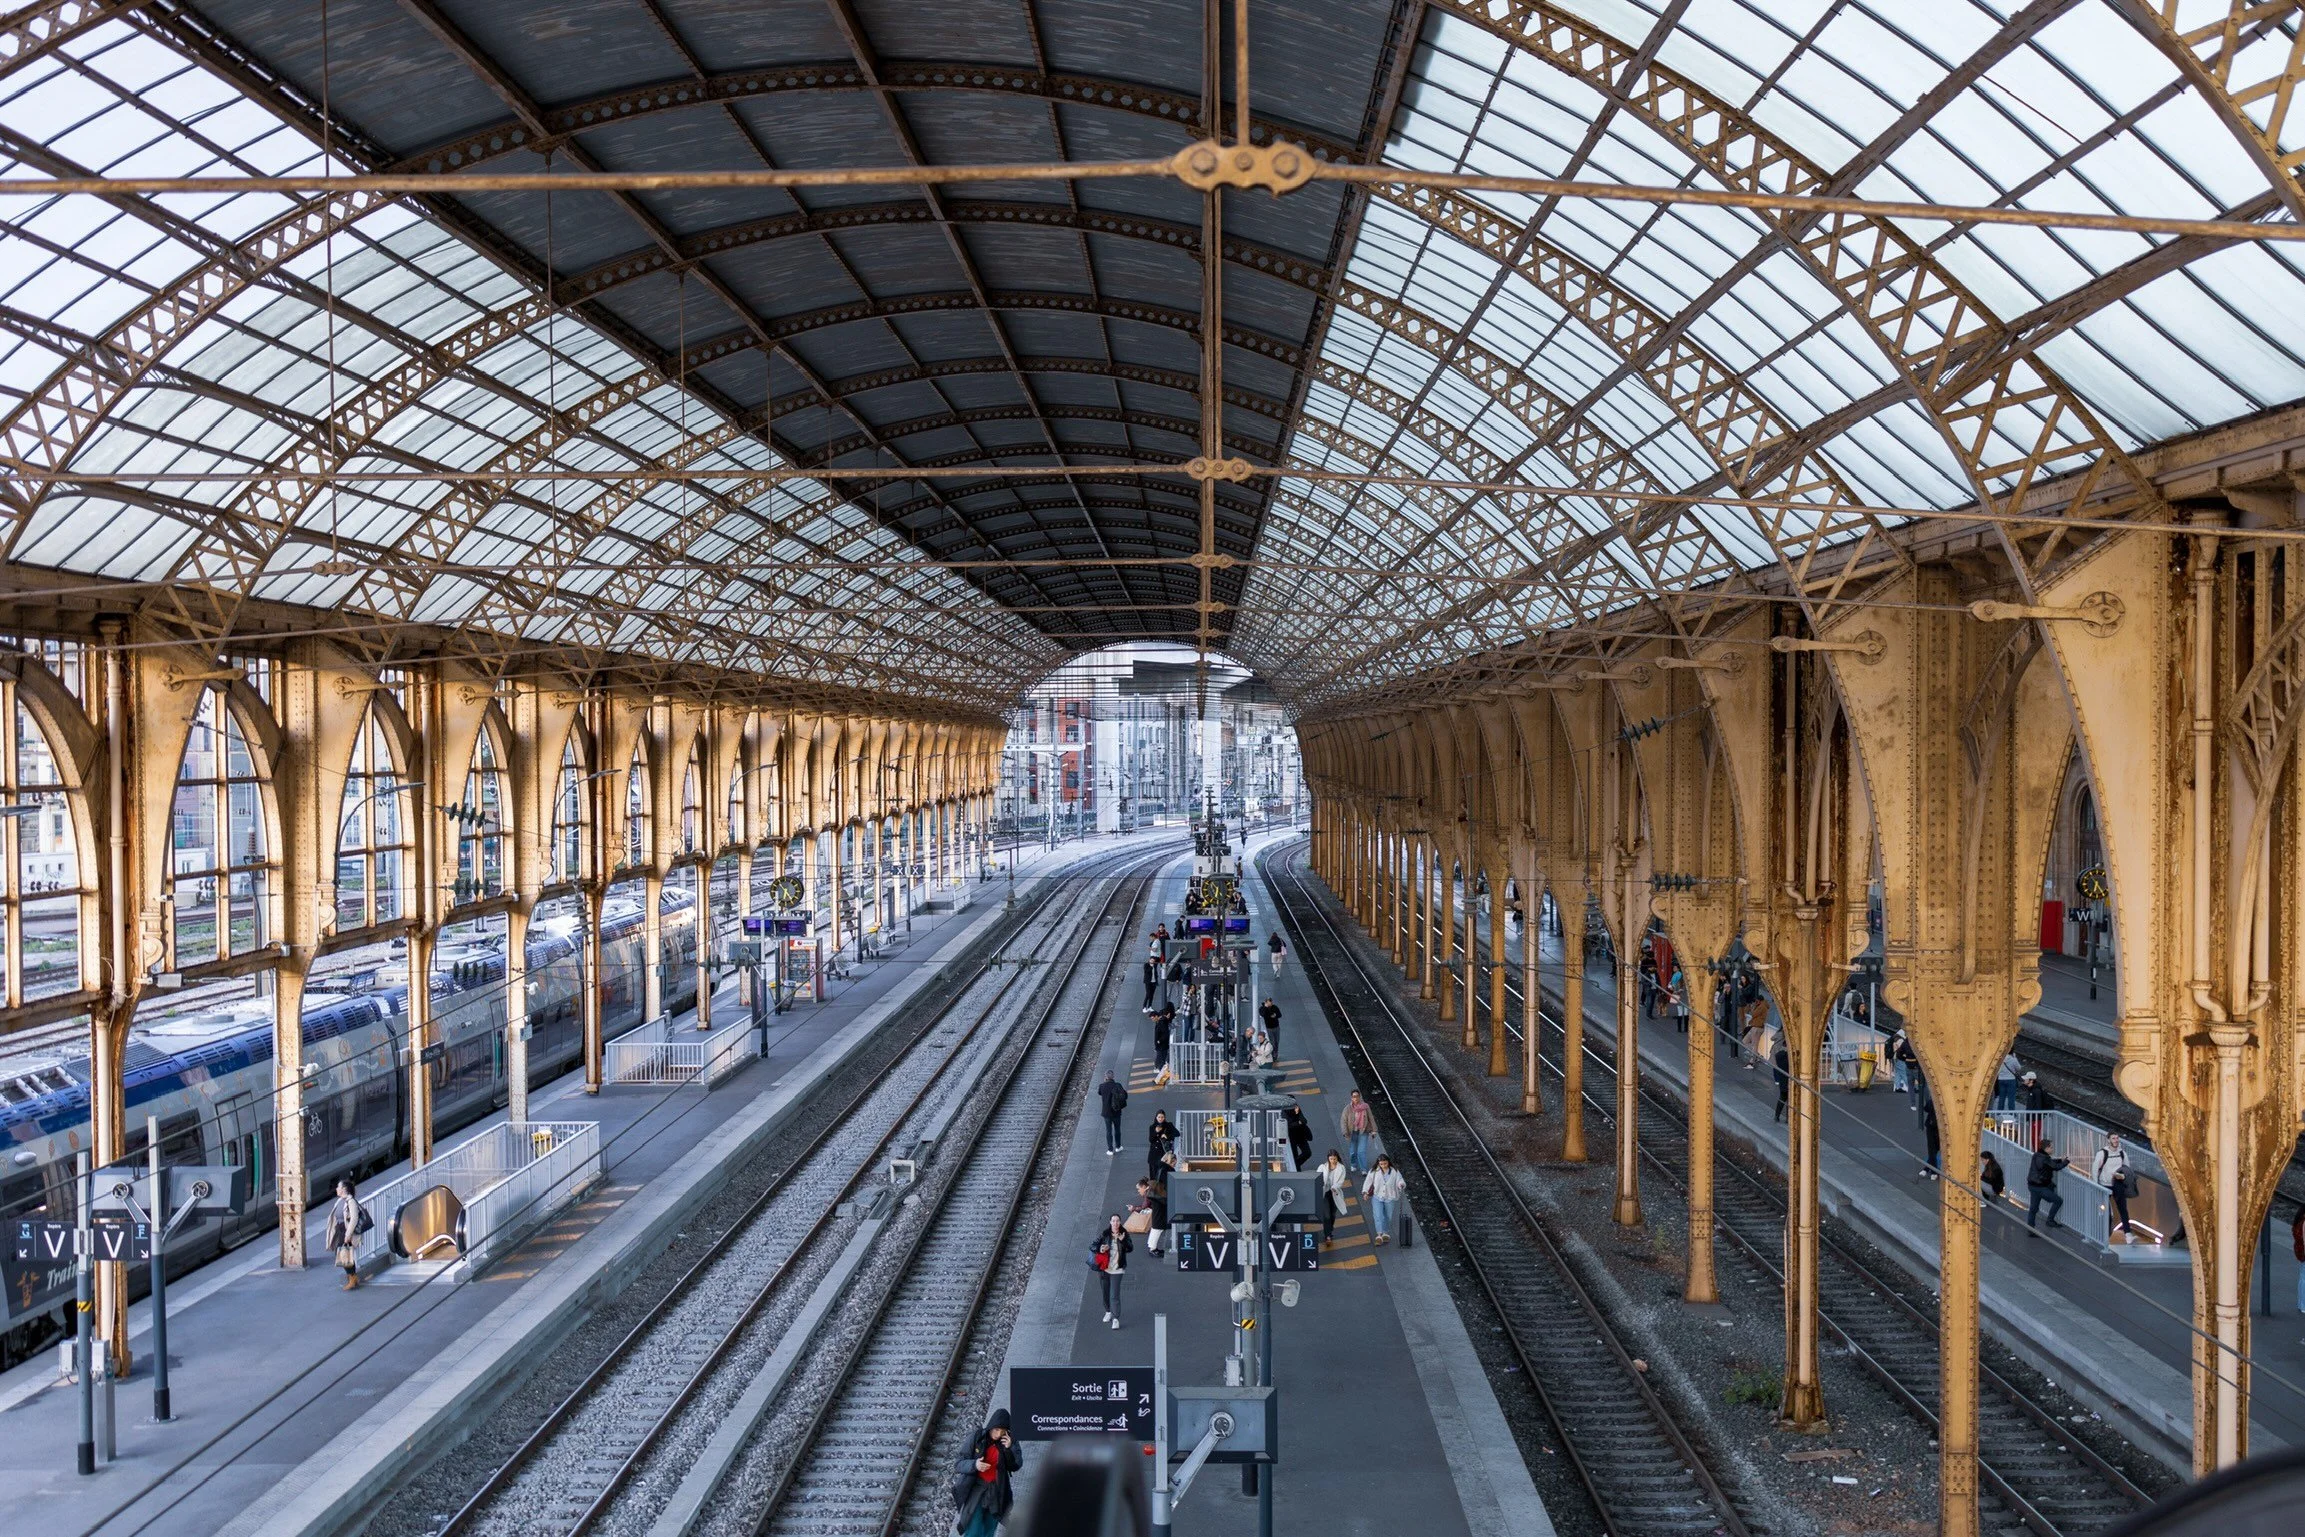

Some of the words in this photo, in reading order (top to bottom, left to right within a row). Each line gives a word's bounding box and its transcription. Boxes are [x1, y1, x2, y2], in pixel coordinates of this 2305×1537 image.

[2077, 910, 2089, 920] W
[43, 1230, 66, 1258] V
[102, 1231, 125, 1258] V
[1184, 1239, 1191, 1248] E
[1304, 1238, 1313, 1248] D
[1206, 1242, 1229, 1269] V
[1268, 1242, 1291, 1269] V
[1072, 1383, 1103, 1393] Sortie
[1031, 1414, 1103, 1425] Correspondances
